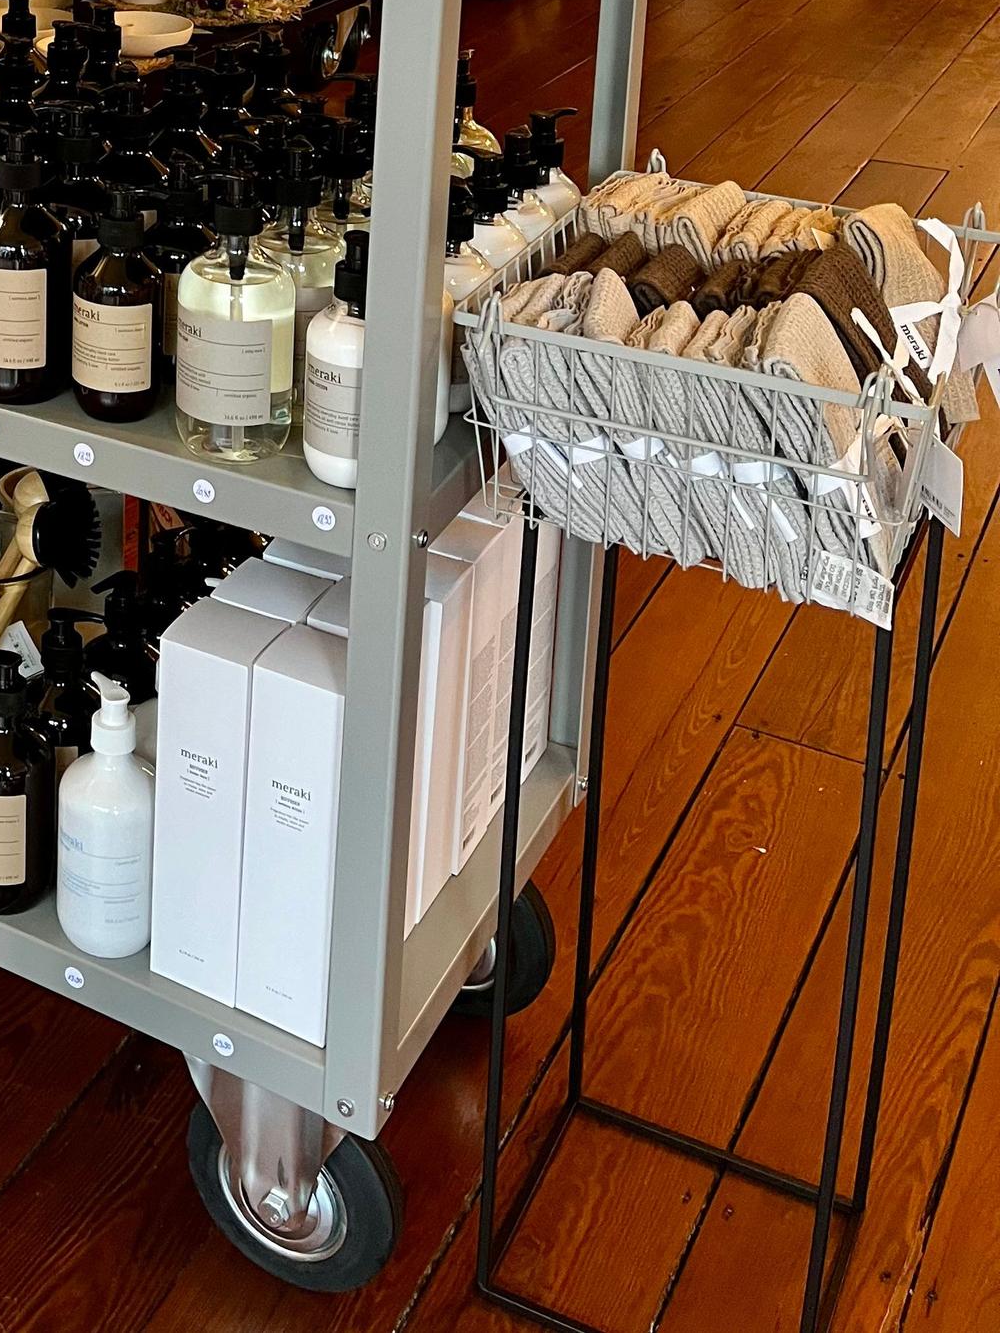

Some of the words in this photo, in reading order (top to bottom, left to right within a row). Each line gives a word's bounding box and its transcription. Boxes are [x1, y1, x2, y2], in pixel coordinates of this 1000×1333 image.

[900, 323, 927, 361] meraki
[307, 363, 341, 384] meraki
[180, 748, 218, 769] meraki
[271, 779, 312, 801] meraki
